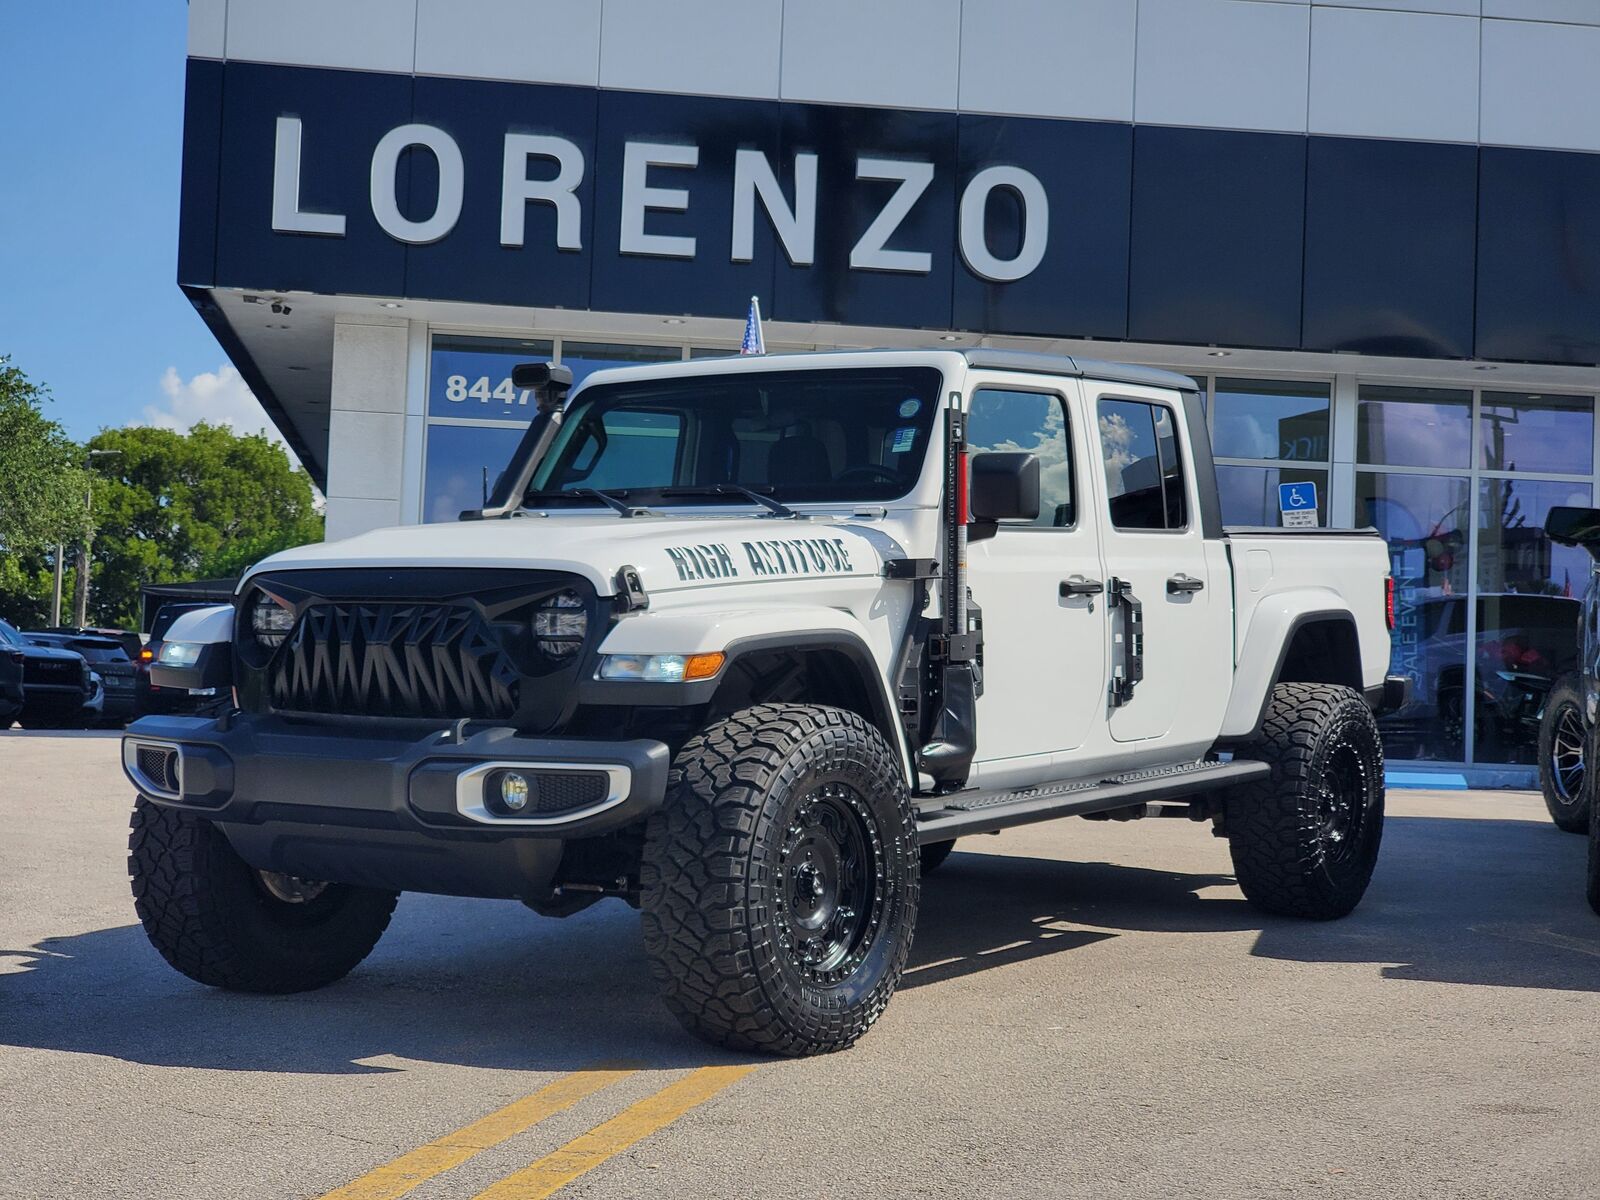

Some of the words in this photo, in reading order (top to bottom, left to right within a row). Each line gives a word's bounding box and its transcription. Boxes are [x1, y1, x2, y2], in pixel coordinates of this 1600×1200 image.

[272, 117, 1050, 282] LORENZO
[664, 543, 738, 581] HIGH
[741, 538, 854, 577] ALTITUDE
[1399, 566, 1417, 627] EVENT
[1401, 632, 1420, 687] SALE
